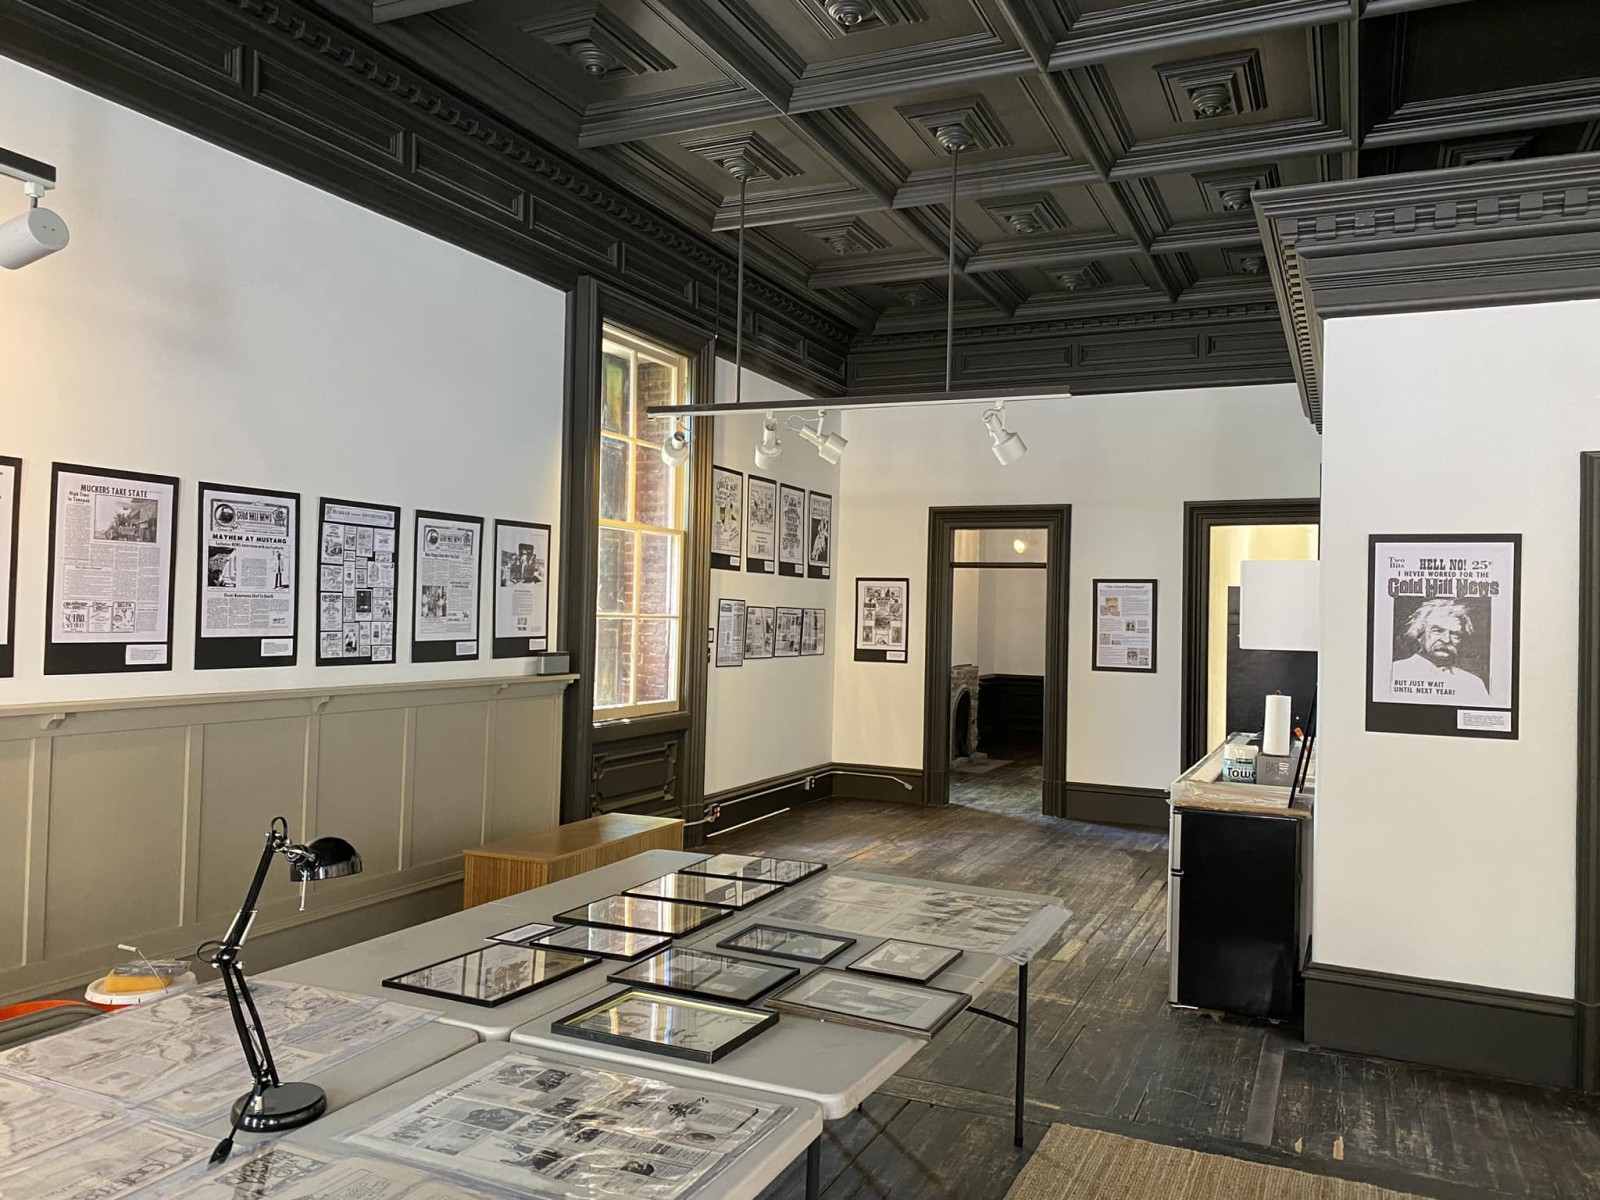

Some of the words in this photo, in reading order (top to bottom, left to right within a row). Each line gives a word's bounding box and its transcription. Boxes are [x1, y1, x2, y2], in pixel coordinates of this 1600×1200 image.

[81, 484, 110, 494] MUCKERS
[128, 489, 147, 498] STATE
[256, 536, 287, 544] MUSTANG
[1420, 558, 1446, 571] HELL
[1450, 559, 1467, 571] NO!
[1388, 578, 1425, 597] Gold
[1425, 578, 1454, 598] Hill
[1456, 578, 1499, 598] News
